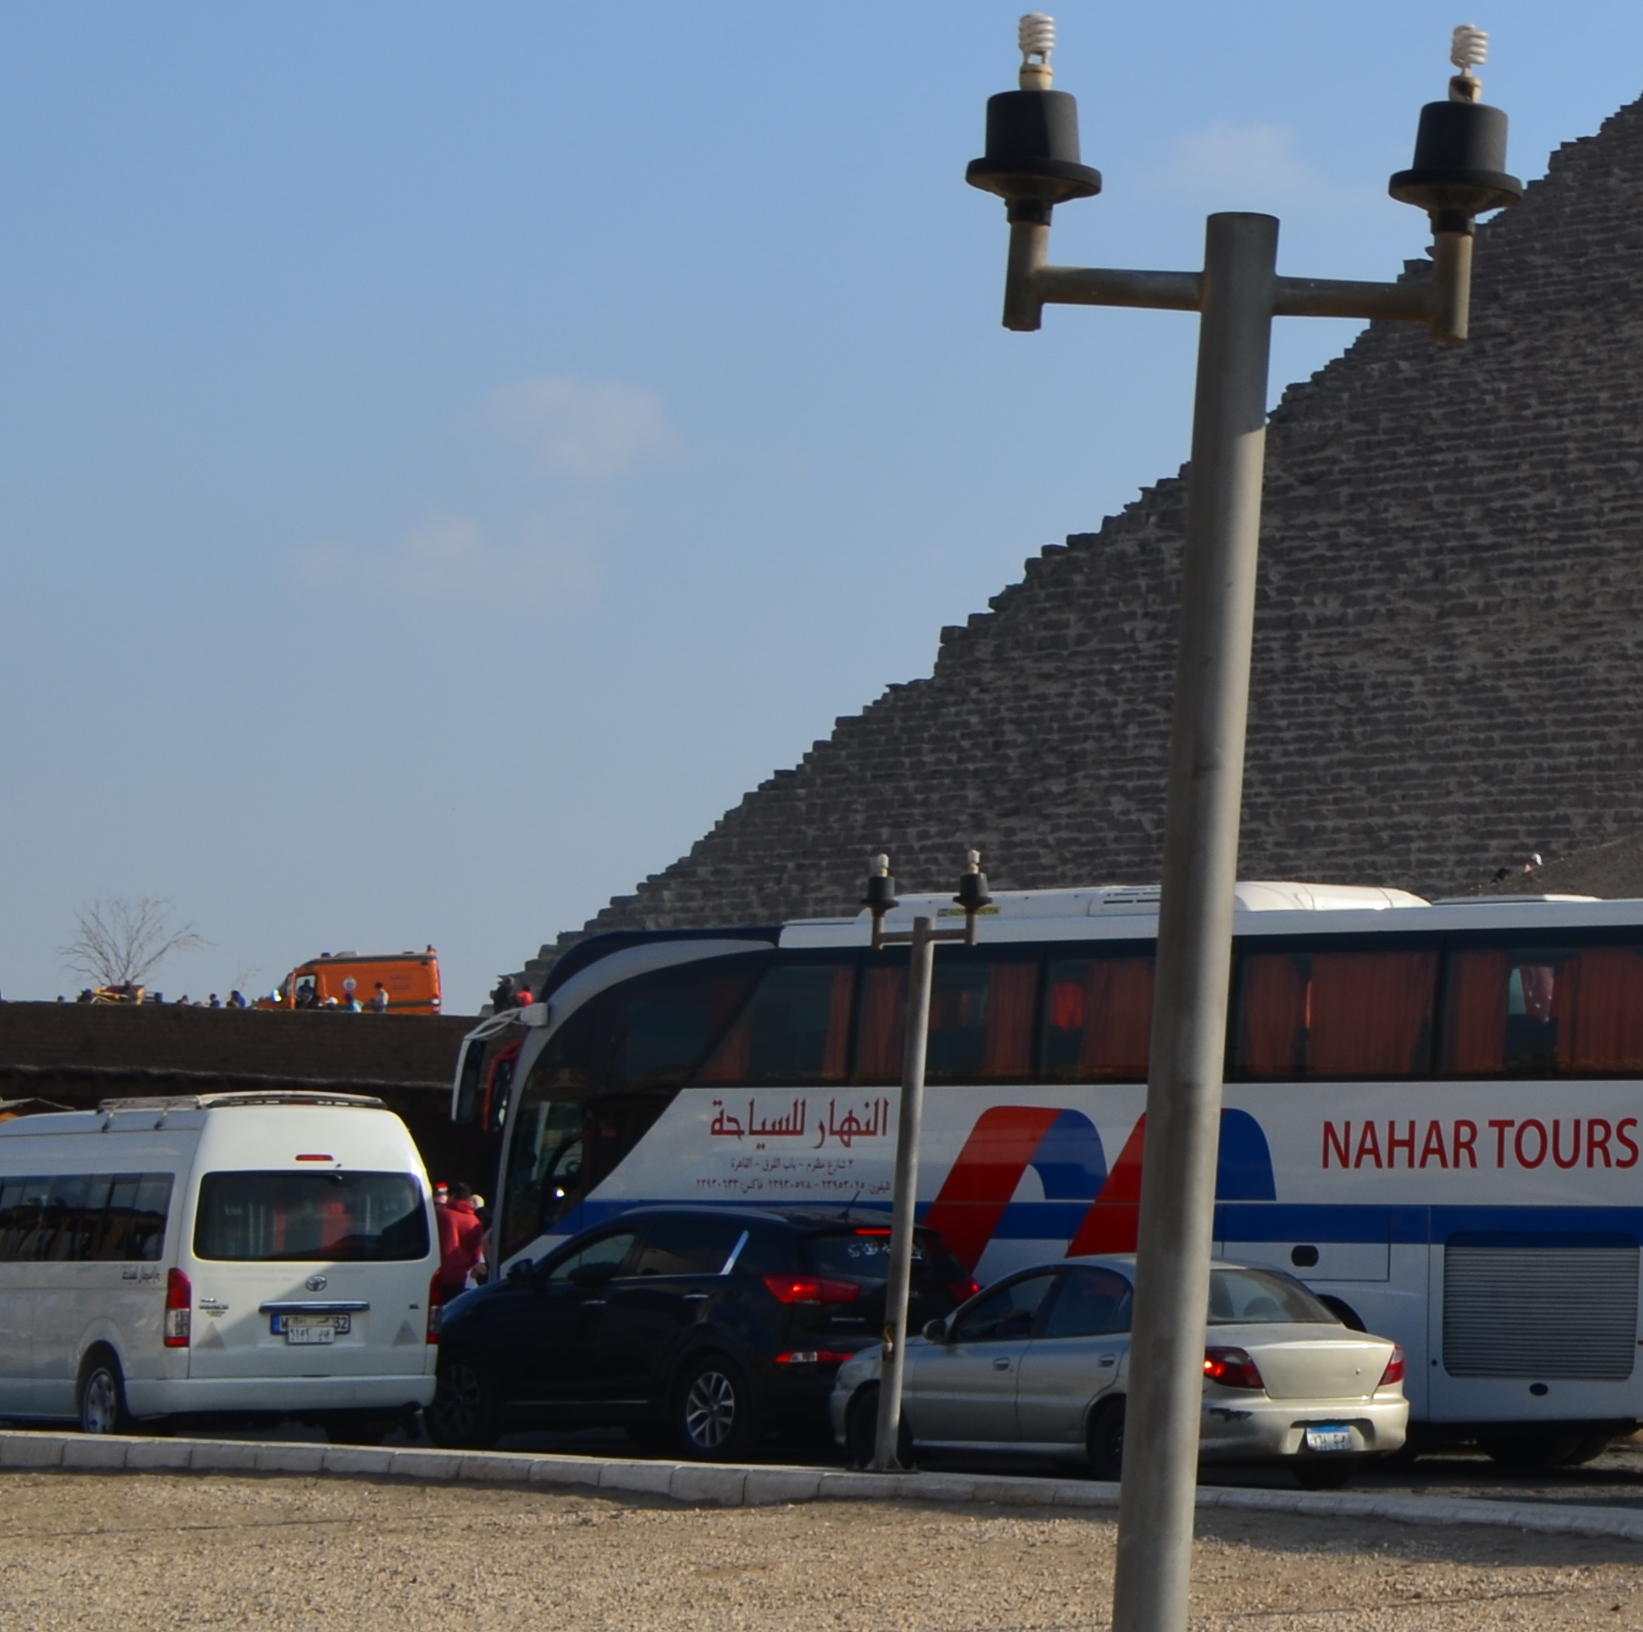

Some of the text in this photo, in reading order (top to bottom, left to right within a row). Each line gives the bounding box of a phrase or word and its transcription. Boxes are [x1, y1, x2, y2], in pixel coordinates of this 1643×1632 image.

[710, 1098, 889, 1150] النهار للسياحة
[1322, 1118, 1640, 1169] NAHAR TOURS
